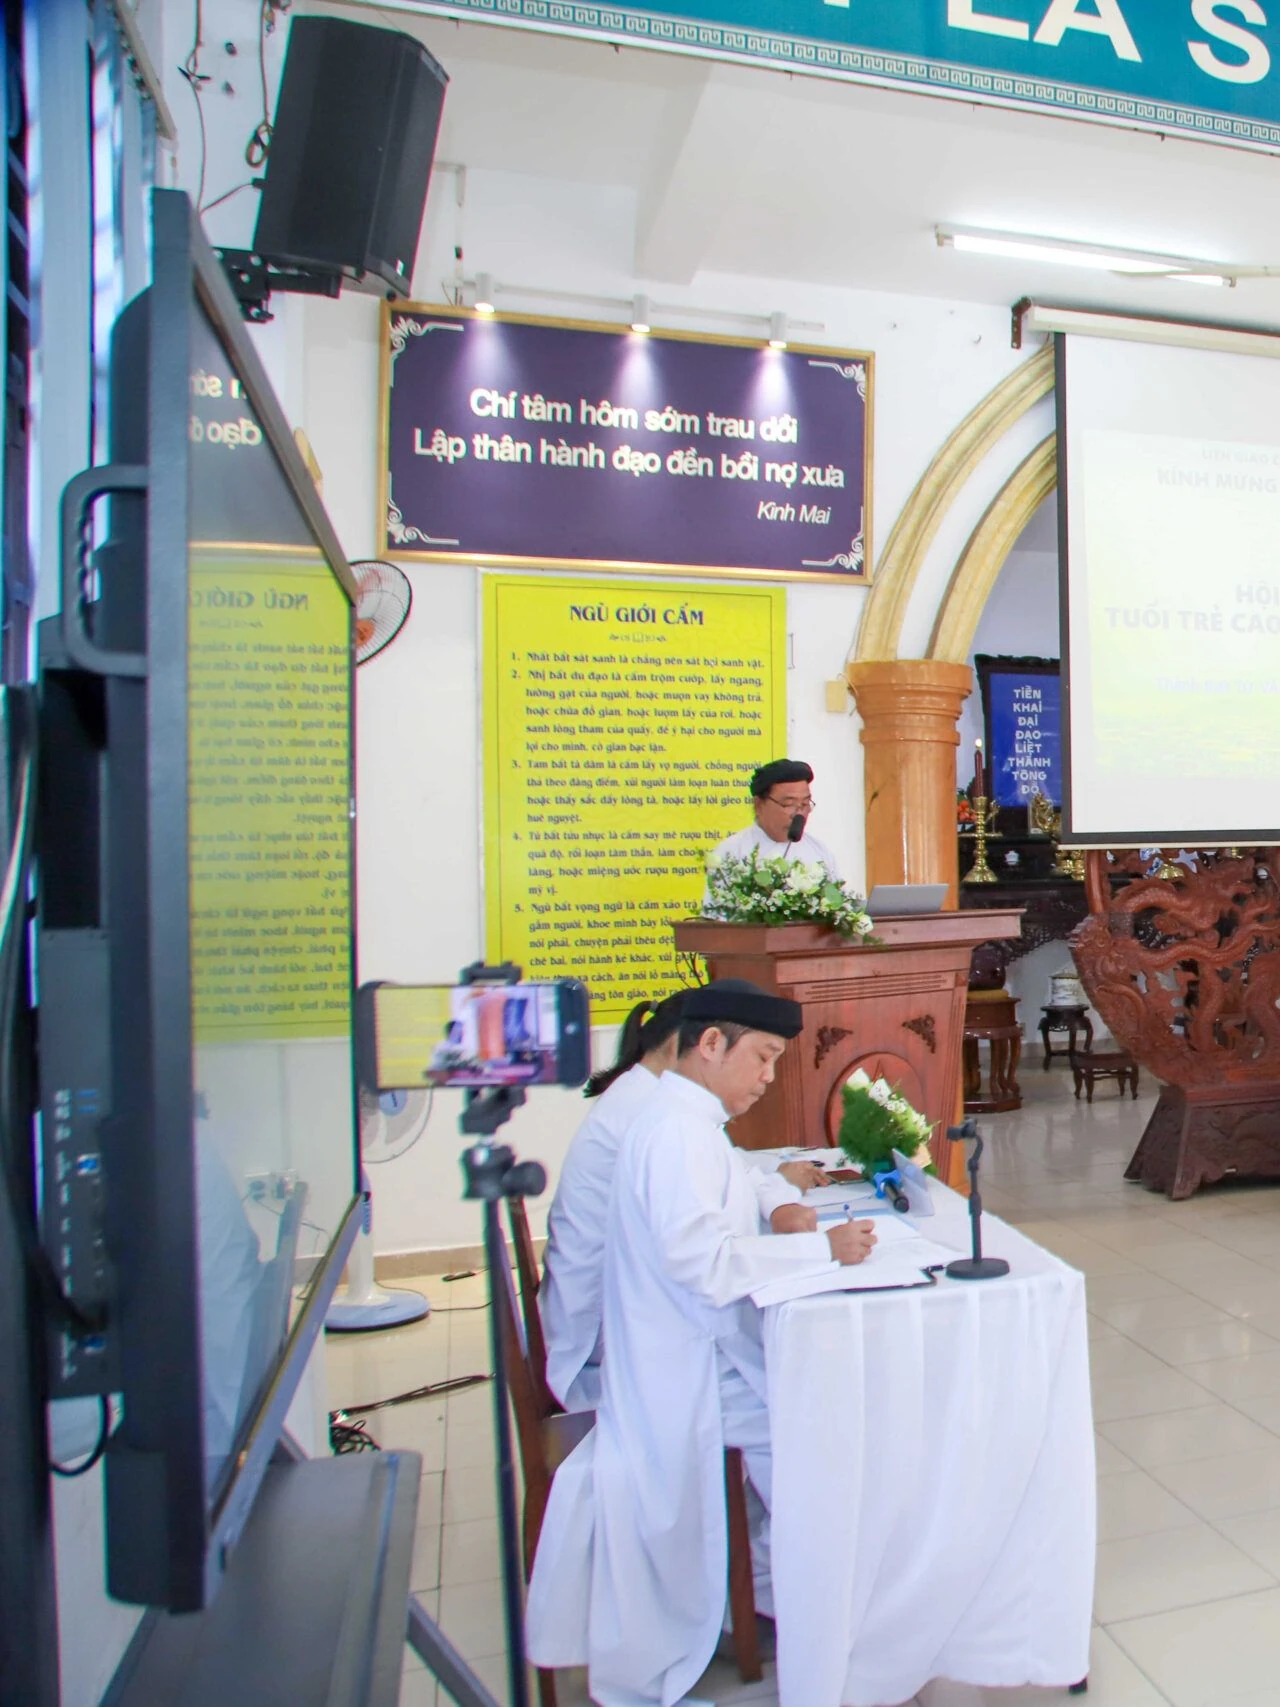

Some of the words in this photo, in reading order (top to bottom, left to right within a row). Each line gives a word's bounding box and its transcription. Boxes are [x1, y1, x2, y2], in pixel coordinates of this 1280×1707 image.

[470, 388, 517, 419] Chí
[522, 394, 571, 423] tâm
[580, 400, 639, 431] hôm
[644, 405, 700, 434] sớm
[707, 412, 755, 439] trau
[759, 412, 798, 444] dồi
[415, 428, 465, 463] Lập
[473, 433, 532, 463] thân
[539, 438, 606, 469] hành
[613, 443, 661, 477] đạo
[666, 446, 714, 477] đền
[721, 451, 759, 481] bồi
[764, 461, 798, 489] nợ
[802, 464, 845, 489] xưa
[757, 501, 795, 522] Kinh
[799, 504, 831, 524] Mai
[1235, 580, 1280, 611] HỘI
[570, 602, 608, 622] NGŨ
[616, 603, 657, 623] GIỚI
[663, 602, 704, 625] CẤM
[1104, 599, 1169, 629] TUỔI
[1177, 604, 1223, 632] TRẺ
